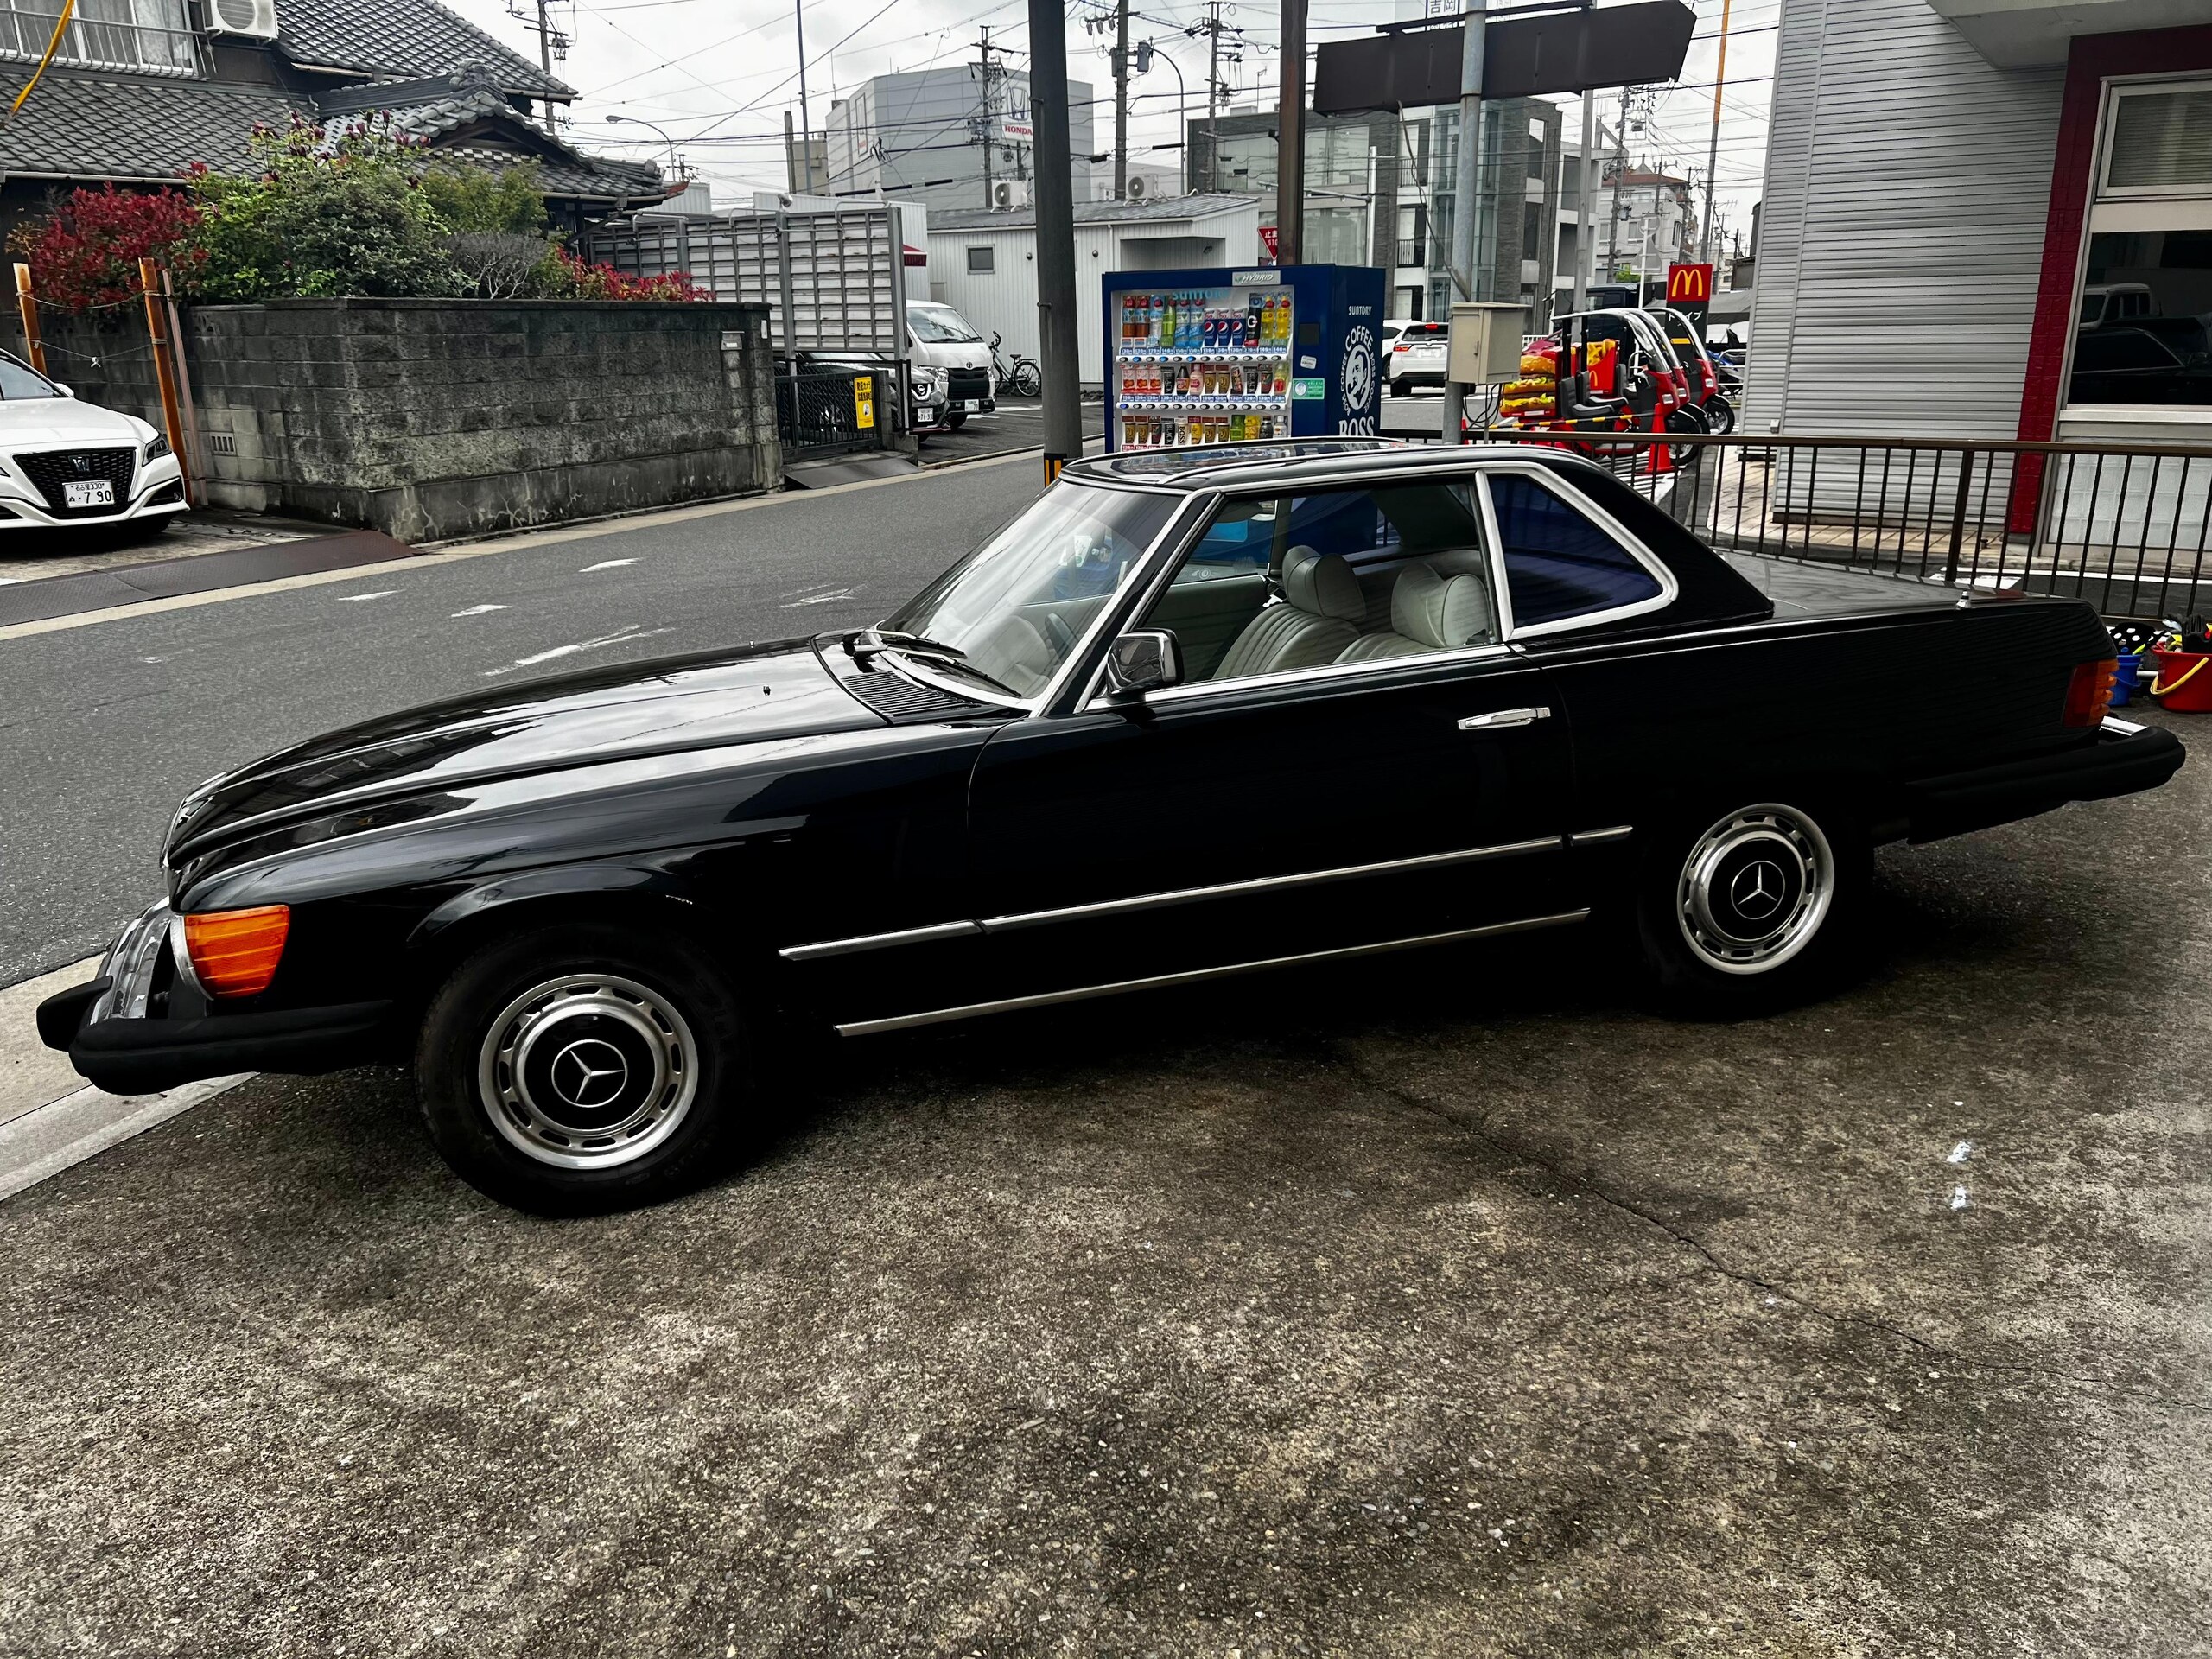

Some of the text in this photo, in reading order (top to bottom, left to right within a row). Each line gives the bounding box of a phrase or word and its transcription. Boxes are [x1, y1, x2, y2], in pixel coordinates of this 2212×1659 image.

[1005, 125, 1033, 136] HONDA
[1242, 274, 1274, 284] HYBRID
[1348, 305, 1372, 315] SUNTORY
[1345, 325, 1374, 352] COFFEE
[1338, 416, 1375, 436] BOSS
